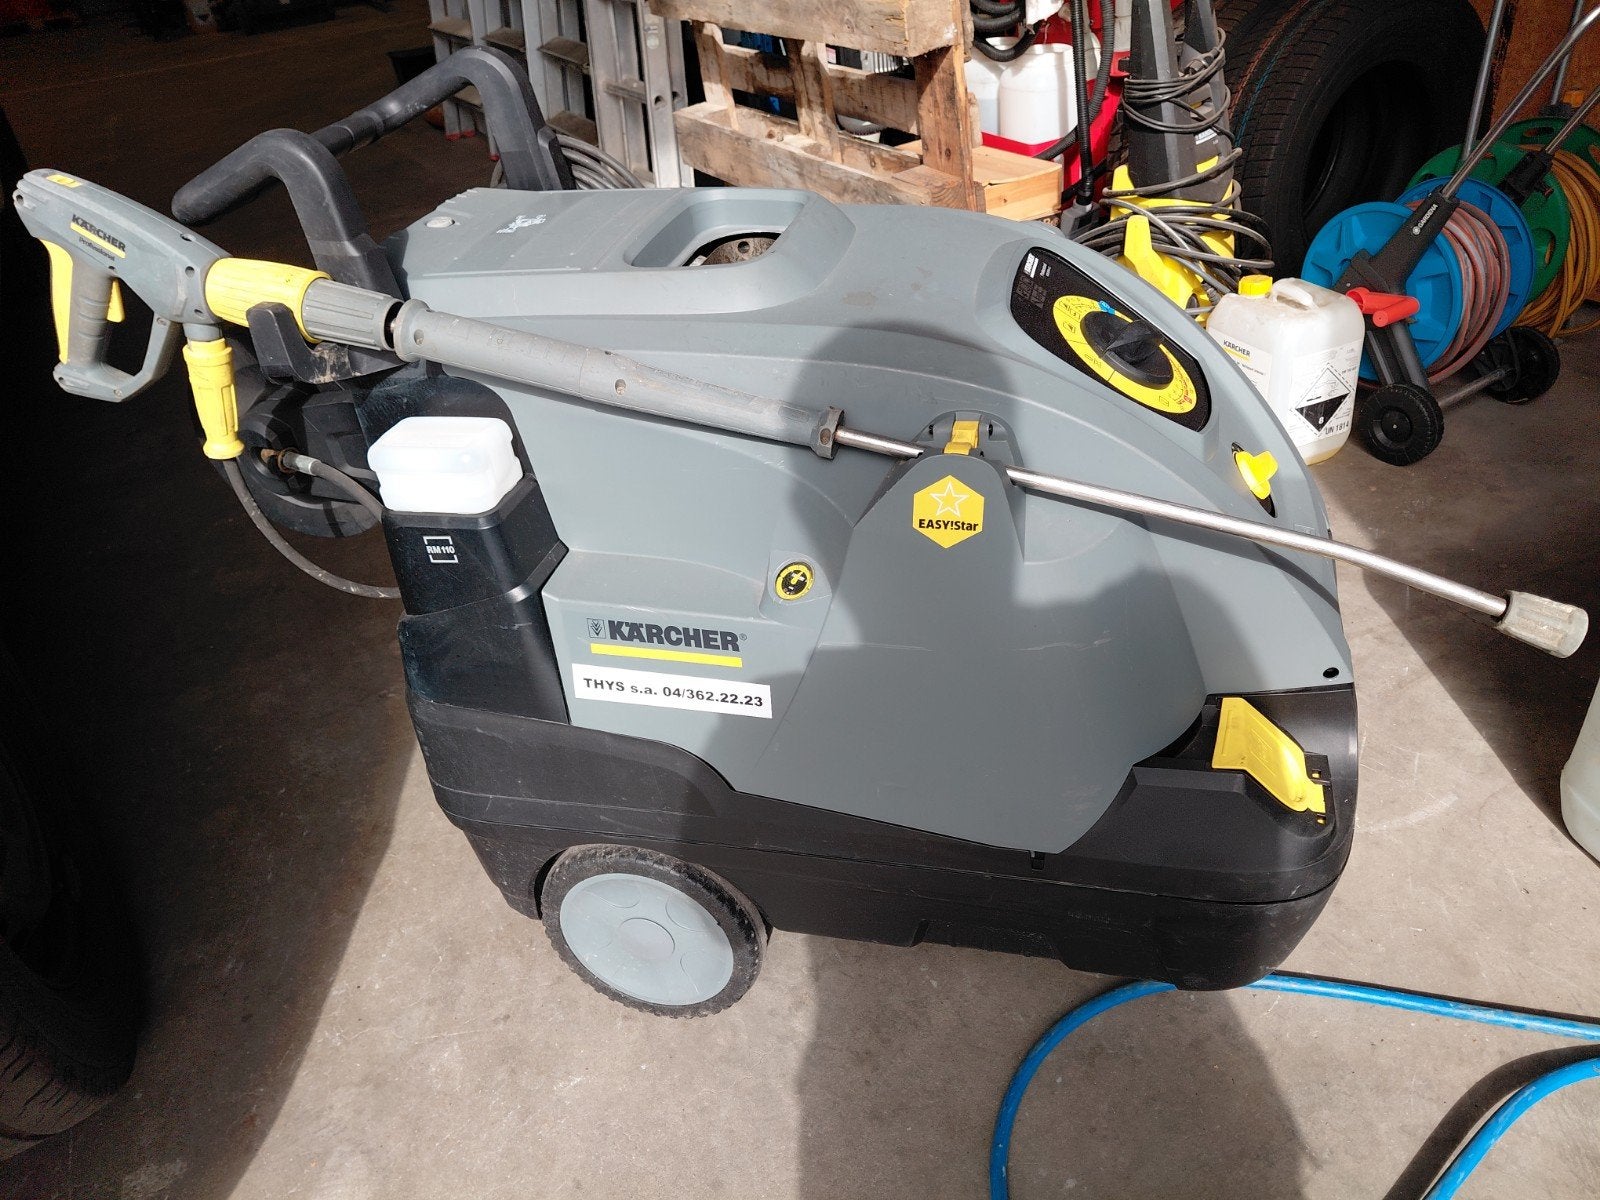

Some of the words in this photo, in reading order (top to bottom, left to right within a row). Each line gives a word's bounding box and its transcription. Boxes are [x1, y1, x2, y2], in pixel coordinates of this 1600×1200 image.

[1417, 203, 1439, 229] GARDENA
[79, 236, 115, 261] Professional
[1318, 416, 1325, 424] 8
[1325, 426, 1334, 435] UN
[1335, 421, 1350, 431] 1814
[918, 518, 979, 532] EASY!Star
[583, 677, 625, 692] THYS
[630, 683, 658, 696] s.a.
[662, 685, 763, 707] 04/362.22.23
